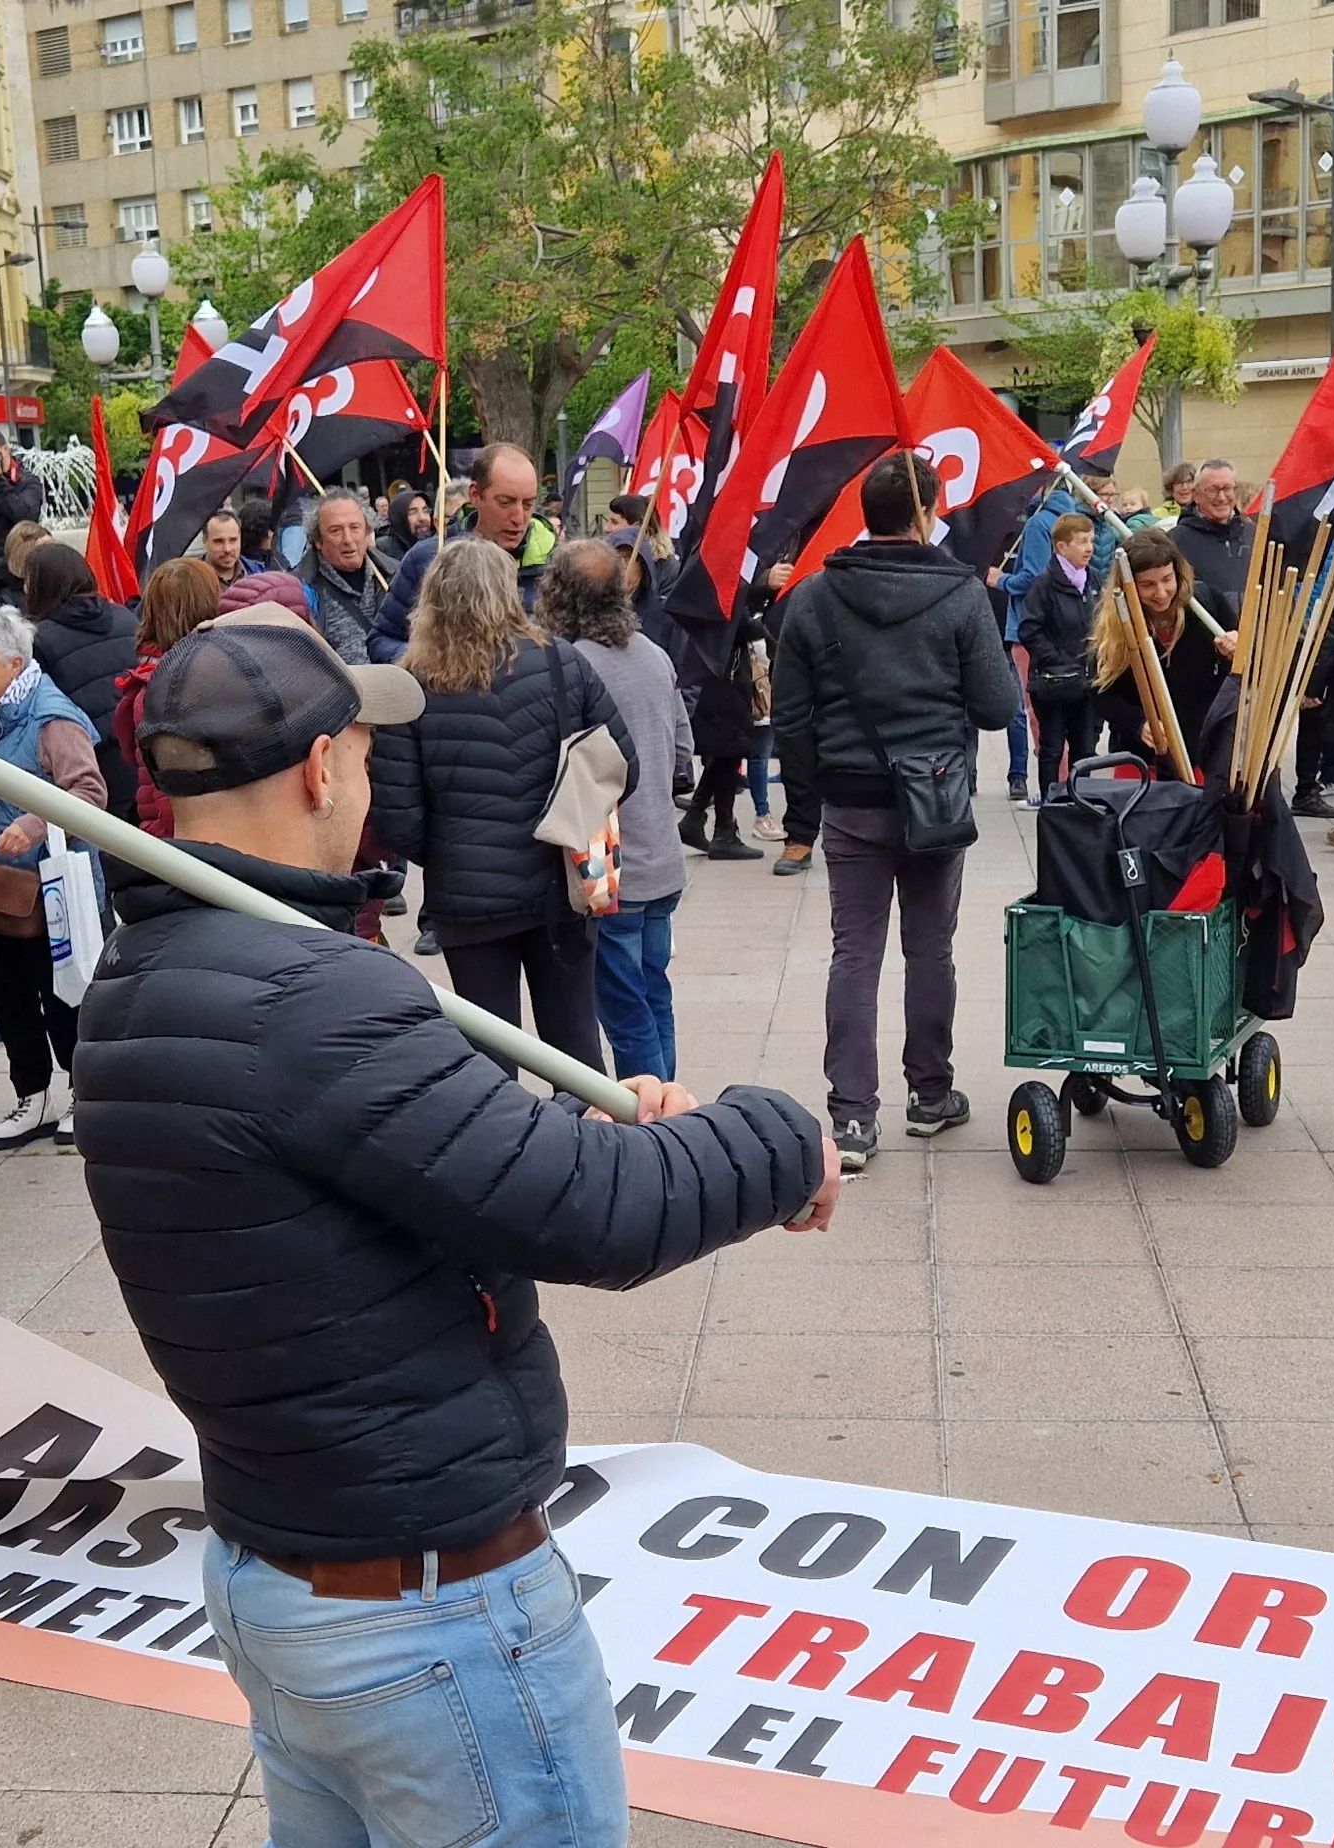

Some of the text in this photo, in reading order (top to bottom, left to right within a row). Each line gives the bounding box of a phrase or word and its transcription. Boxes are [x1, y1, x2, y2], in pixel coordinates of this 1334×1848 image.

[1082, 1062, 1129, 1075] AREBOS
[638, 1495, 1018, 1606] CON
[707, 1703, 843, 1778] EL
